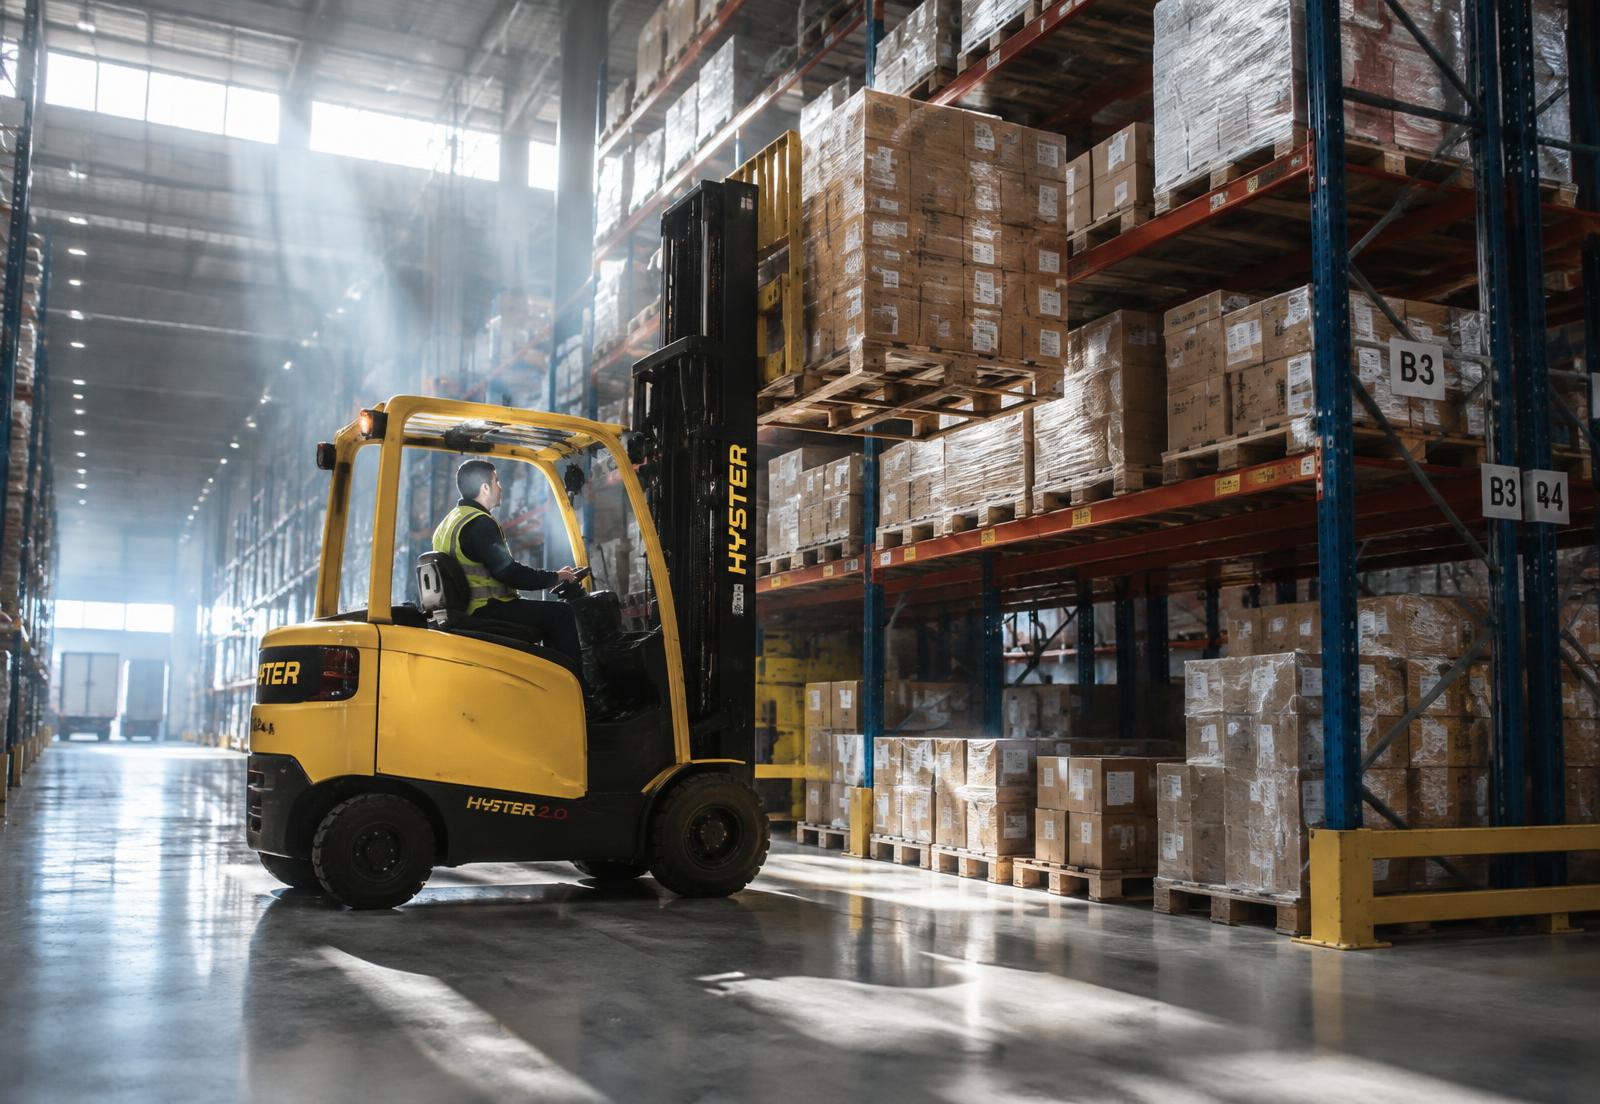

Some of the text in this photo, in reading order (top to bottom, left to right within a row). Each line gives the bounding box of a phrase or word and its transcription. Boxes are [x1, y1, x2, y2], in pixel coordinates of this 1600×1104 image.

[1400, 350, 1434, 385] B3
[1490, 476, 1517, 508] B3
[728, 444, 747, 575] HYSTER
[466, 796, 535, 816] HYSTER
